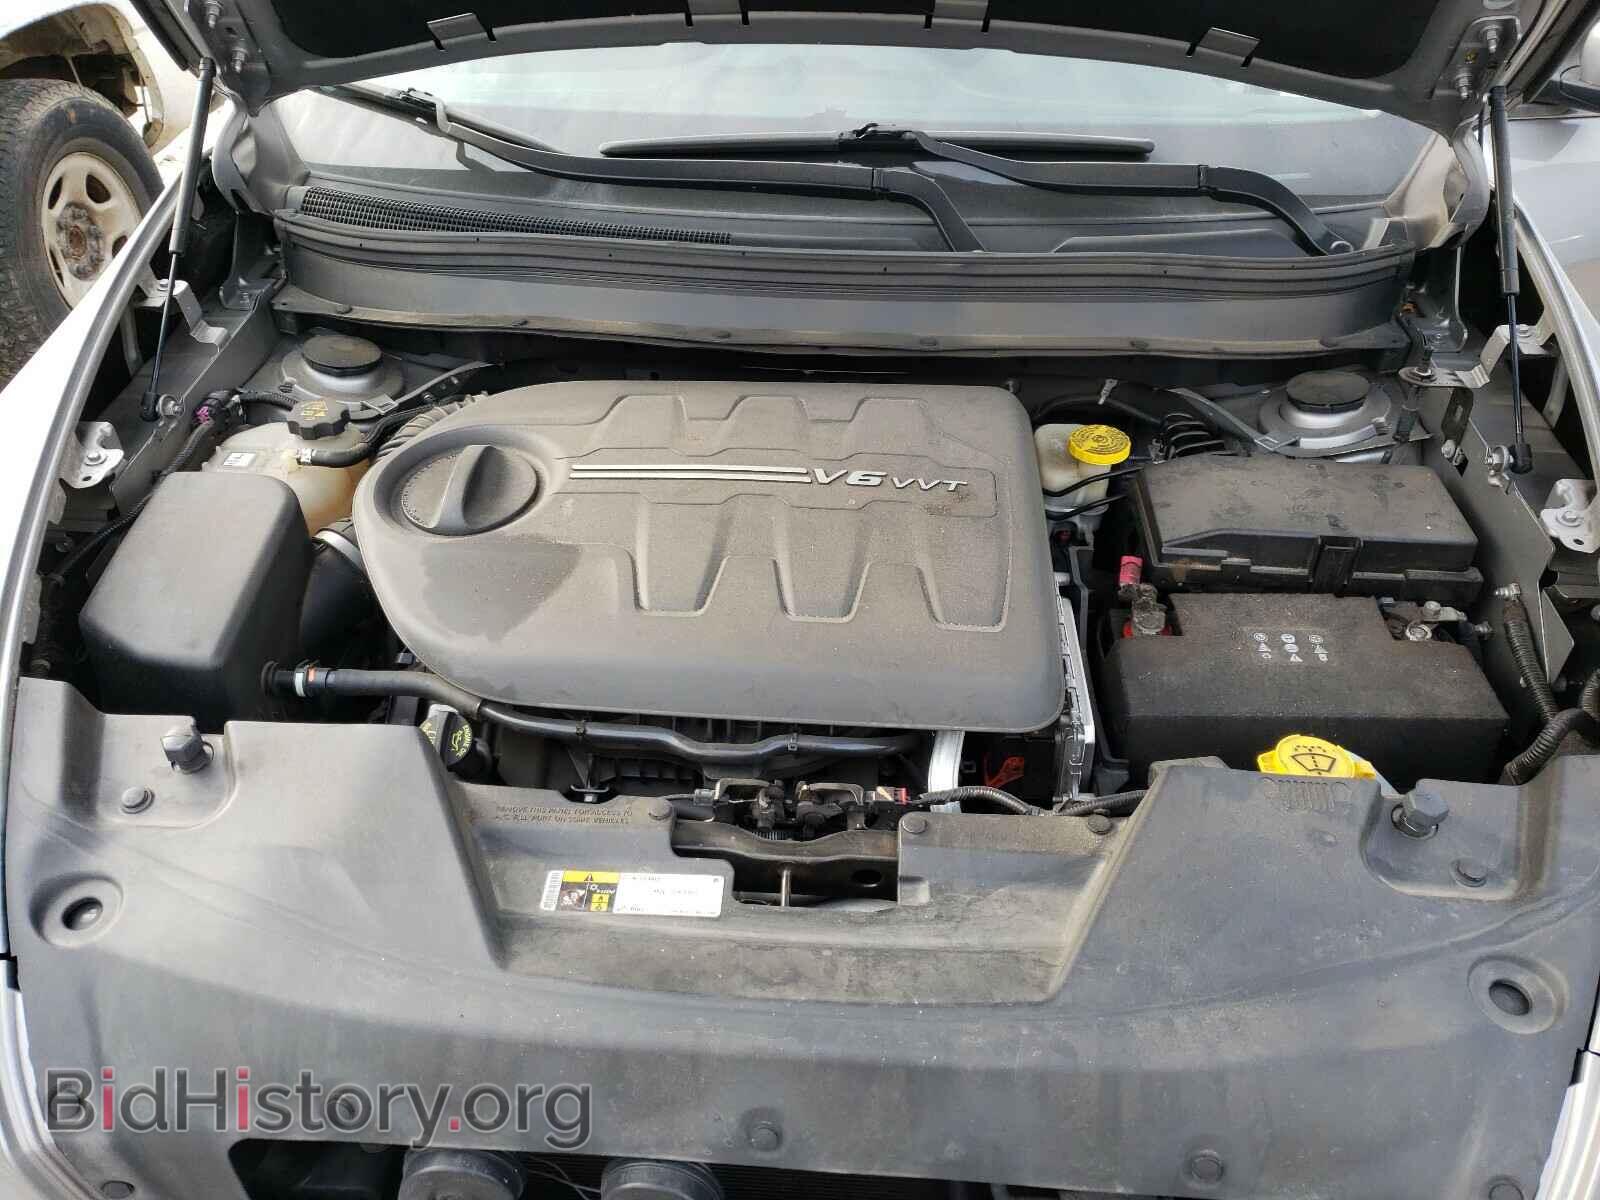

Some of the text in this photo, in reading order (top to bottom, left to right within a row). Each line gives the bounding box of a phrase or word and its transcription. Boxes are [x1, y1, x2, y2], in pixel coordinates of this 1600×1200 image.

[814, 467, 968, 491] V6 VVT
[462, 724, 473, 748] ENGINE
